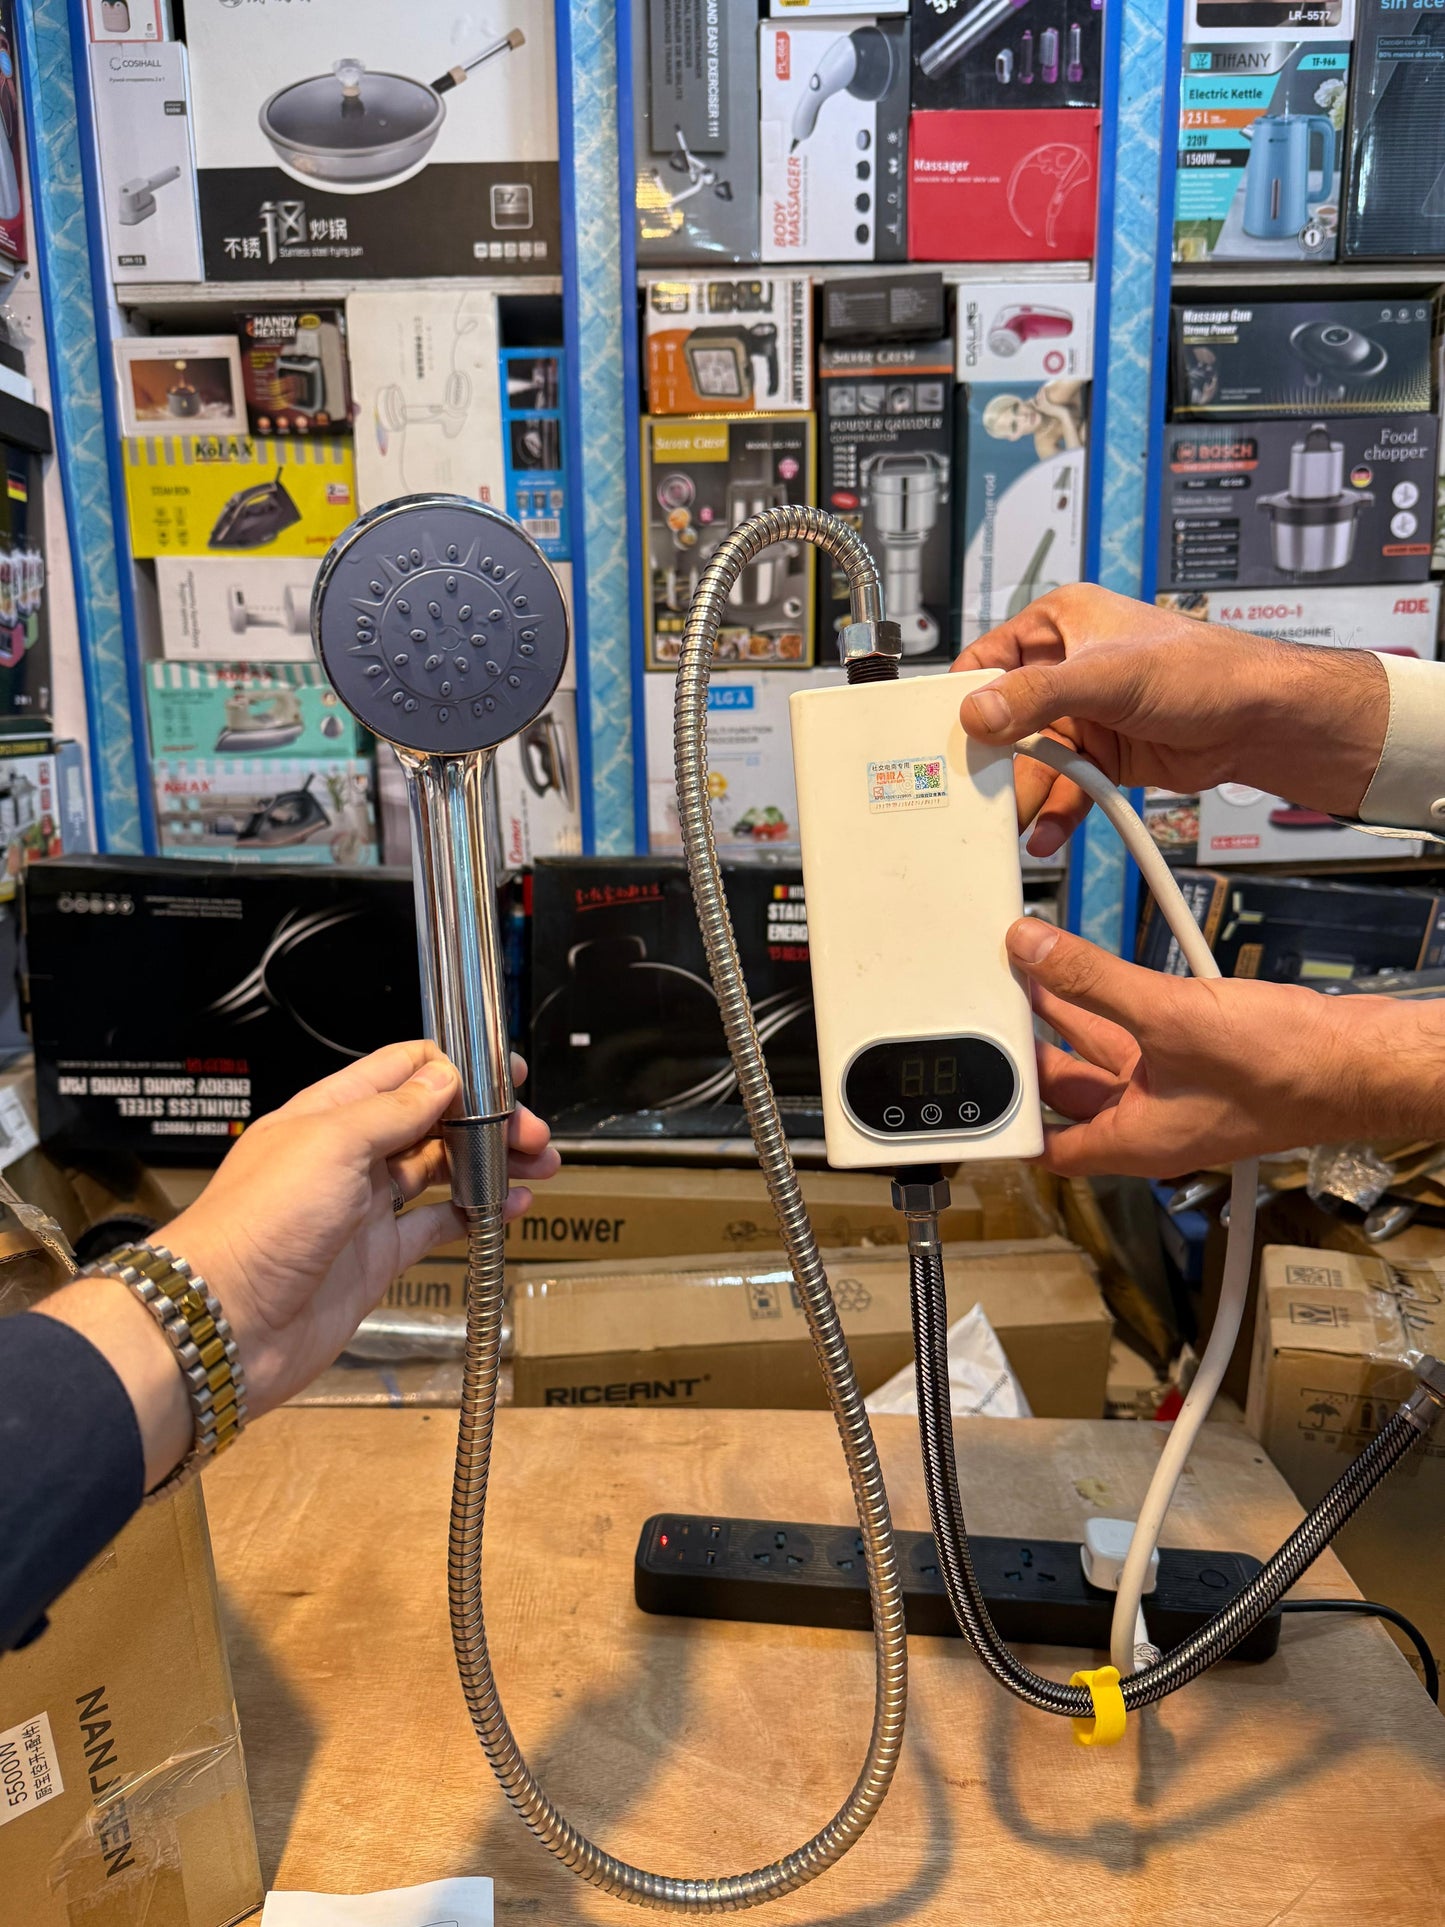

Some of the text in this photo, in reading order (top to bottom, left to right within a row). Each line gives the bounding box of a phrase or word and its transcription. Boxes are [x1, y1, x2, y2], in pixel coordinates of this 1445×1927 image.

[1289, 10, 1331, 21] LR-5577
[707, 27, 719, 57] EASY
[707, 58, 720, 119] EXERCISER
[1189, 88, 1263, 99] Electric Kettle
[1187, 111, 1202, 124] 2.5
[1186, 135, 1208, 147] 220V
[914, 159, 970, 174] Massager
[1186, 152, 1216, 166] 1500W
[787, 156, 801, 247] MASSAGER
[774, 201, 787, 248] BODY
[792, 281, 804, 315] SOLAR
[254, 316, 297, 328] HANDY
[1183, 309, 1252, 324] Massage Gun
[254, 327, 296, 338] HEATER
[1183, 324, 1238, 337] Strong Power
[792, 375, 804, 404] LAMP
[1380, 429, 1418, 448] Food
[1200, 444, 1253, 459] BOSCH
[1364, 444, 1428, 462] chopper
[984, 472, 997, 496] rod
[1220, 607, 1242, 620] KA
[1393, 597, 1430, 615] ADE
[58, 1076, 251, 1096] ENERGY SAVING FRYING PAN
[117, 1098, 251, 1118] STAINLESS STEEL
[523, 1216, 626, 1243] mower
[544, 1377, 701, 1406] RICEANT
